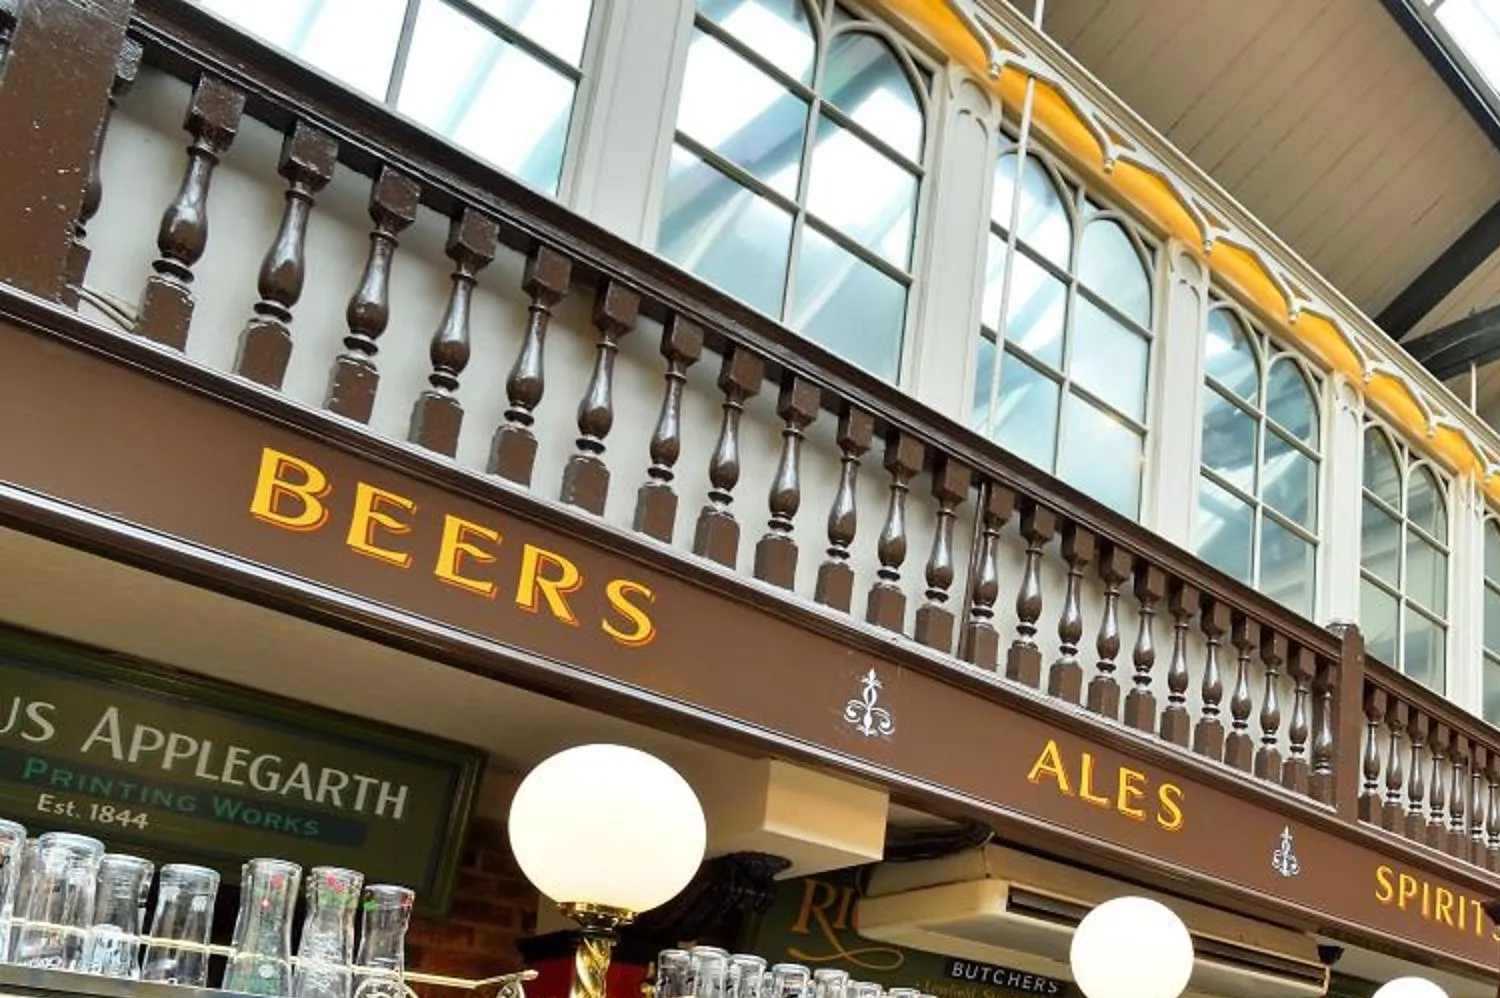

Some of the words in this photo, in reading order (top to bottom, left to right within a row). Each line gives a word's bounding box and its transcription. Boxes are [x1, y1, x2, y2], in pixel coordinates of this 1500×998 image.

[250, 447, 657, 648] BEERS
[22, 757, 199, 813] PRINTING
[211, 794, 321, 837] WORKS
[80, 705, 409, 820] APPLEGARTH
[1027, 739, 1185, 832] ALES
[36, 792, 82, 819] Est.
[88, 802, 149, 831] 1844
[951, 961, 1060, 994] BUTCHERS
